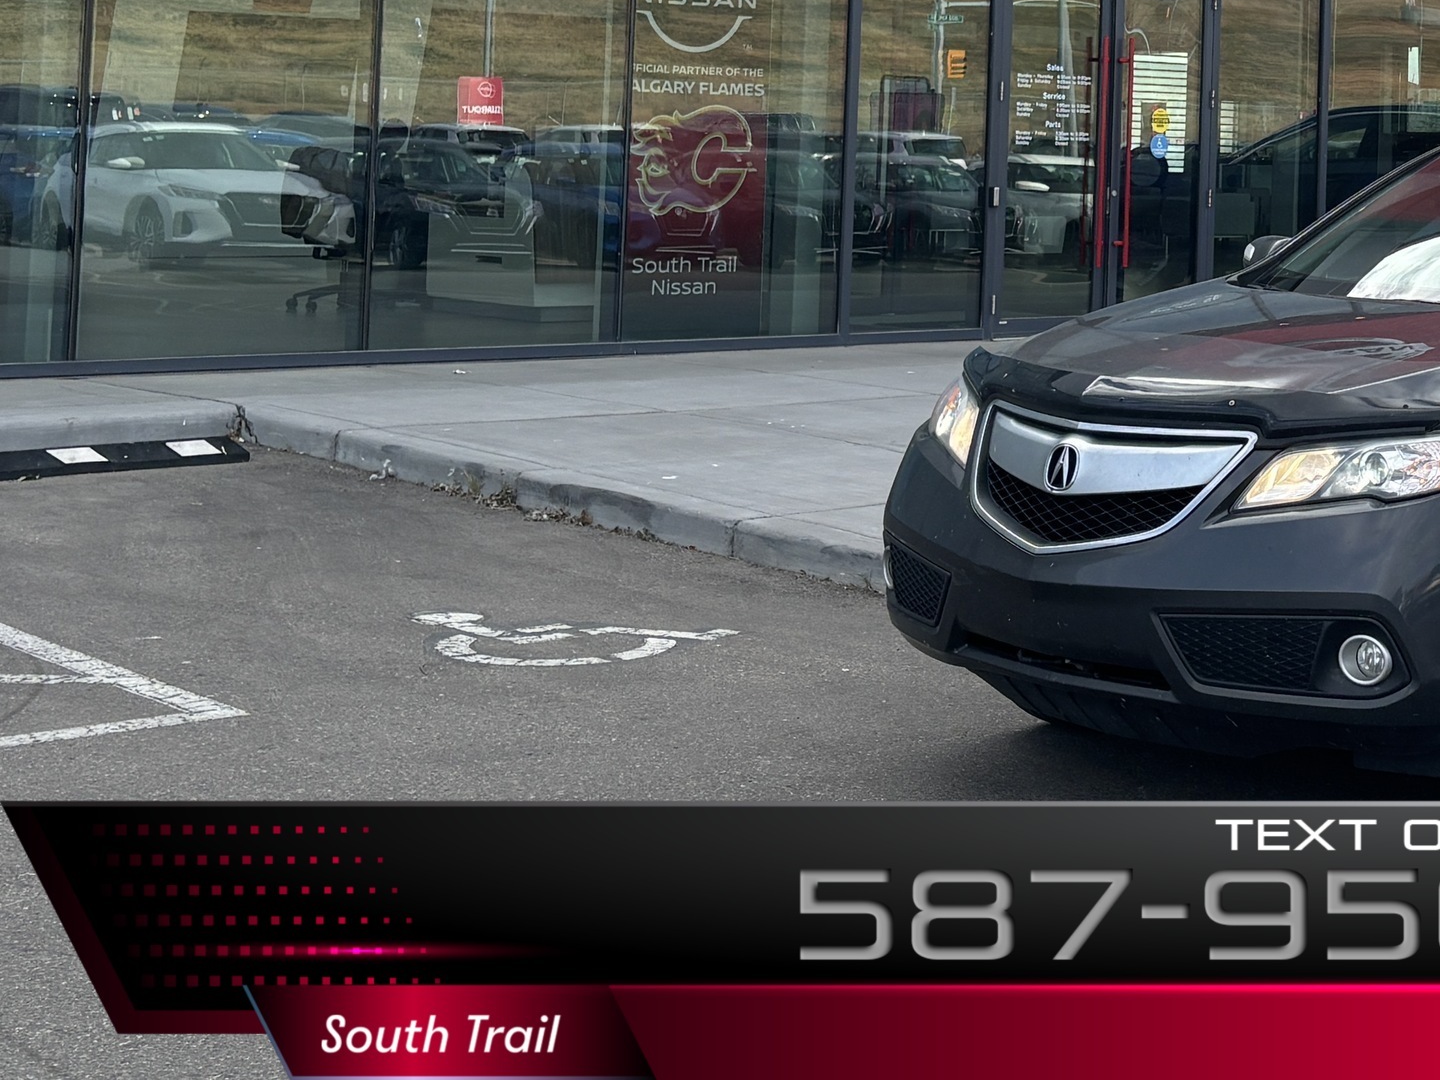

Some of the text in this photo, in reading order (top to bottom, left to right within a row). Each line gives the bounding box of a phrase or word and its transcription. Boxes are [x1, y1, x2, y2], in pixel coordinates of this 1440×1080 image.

[633, 63, 764, 77] FICIAL PARTNER OF THE
[1046, 63, 1064, 72] Sales
[632, 79, 765, 96] ALGARY FLAMES
[1042, 91, 1066, 101] Service
[1045, 120, 1061, 129] Parts
[632, 256, 737, 273] South Trail
[651, 279, 717, 296] Nissan
